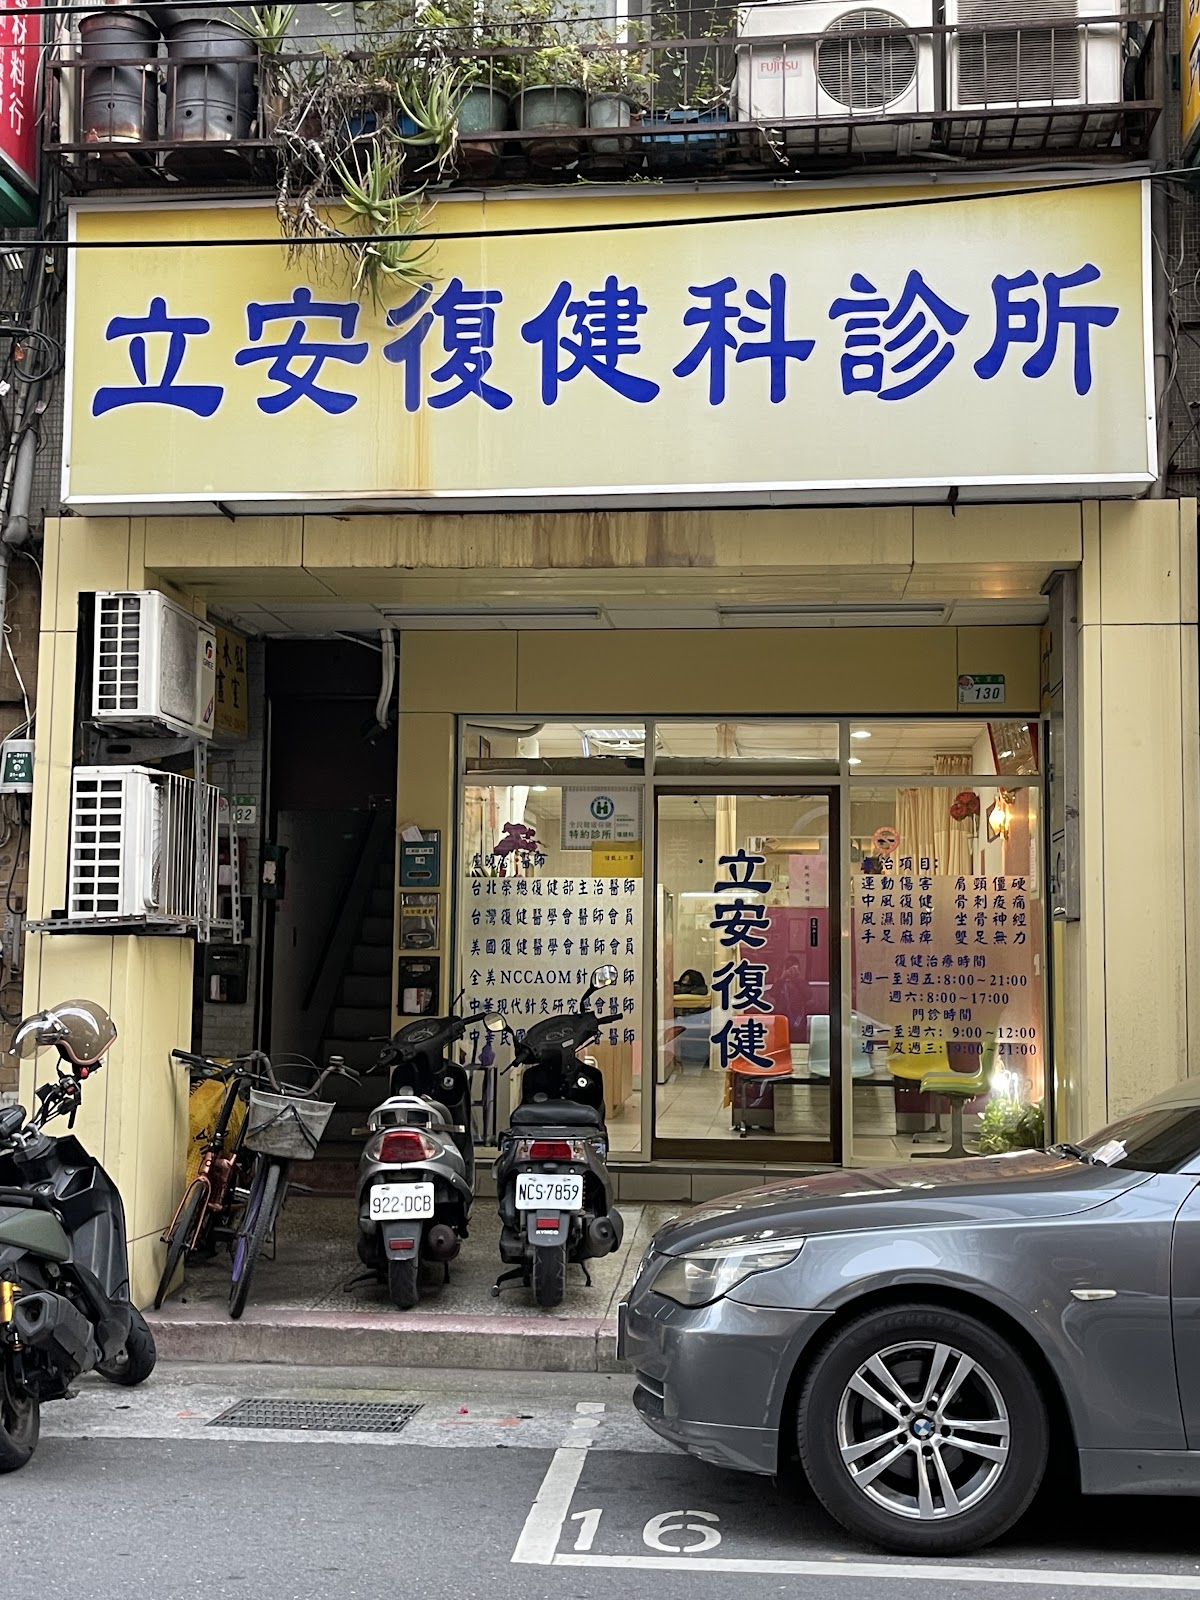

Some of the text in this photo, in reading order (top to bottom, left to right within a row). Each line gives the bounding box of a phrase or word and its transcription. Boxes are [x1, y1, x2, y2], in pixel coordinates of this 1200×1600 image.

[760, 58, 799, 74] FUJITSU
[91, 261, 1121, 418] 立安復健科診所
[974, 687, 1000, 700] 130
[569, 829, 612, 840] 特約診所
[471, 878, 636, 897] 台北榮總復健部主治醫師
[861, 876, 933, 892] 運動傷害
[861, 894, 934, 909] 中風復健
[471, 907, 634, 926] 台灣復健醫學會醫師會員
[861, 911, 1027, 928] 風濕關節 坐骨神經
[954, 930, 1026, 945] 雙足無力
[470, 937, 635, 956] 美國復健醫學會醫師會員
[709, 848, 775, 1070] 立安復健
[894, 954, 987, 968] 復健治療時間
[912, 1008, 972, 1022] 門診時間
